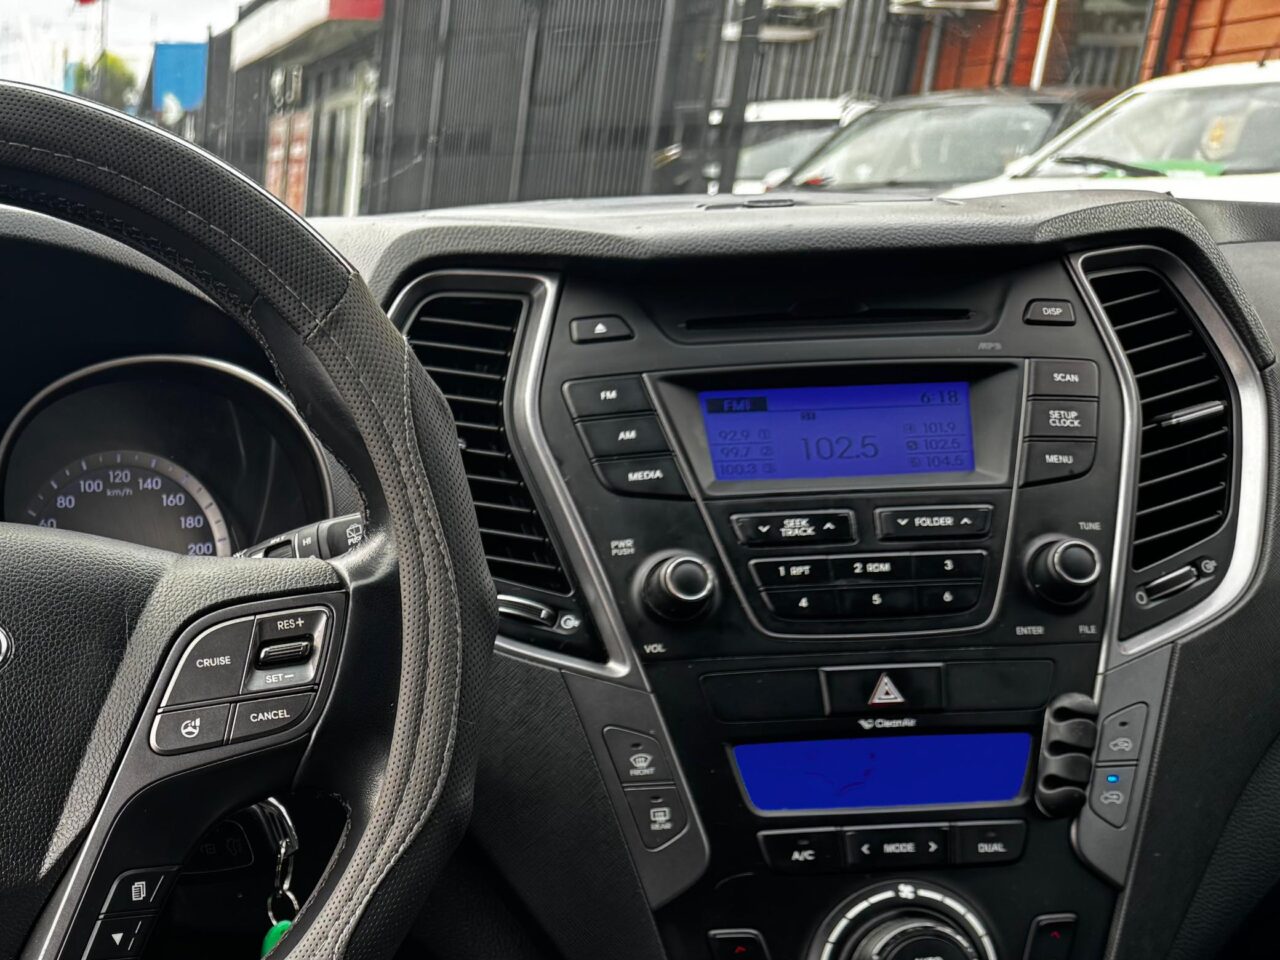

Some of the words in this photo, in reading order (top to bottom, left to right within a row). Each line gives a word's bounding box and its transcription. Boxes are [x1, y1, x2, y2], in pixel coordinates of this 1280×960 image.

[1042, 307, 1063, 316] DISP
[1053, 373, 1080, 382] SCAN
[600, 389, 618, 401] FM
[1048, 410, 1078, 419] SETUP
[1049, 419, 1081, 428] CLOCK
[618, 430, 637, 441] AM
[801, 435, 879, 461] 102.5
[1045, 455, 1073, 464] MENU
[109, 470, 131, 483] 120
[627, 469, 663, 481] MEDIA
[80, 480, 103, 493] 100
[138, 478, 162, 491] 140
[106, 488, 133, 497] km/h
[57, 496, 75, 509] 80
[162, 494, 185, 507] 160
[180, 516, 204, 529] 180
[783, 518, 809, 528] SEEK
[914, 517, 954, 527] FOLDER
[1078, 521, 1102, 531] TUNE
[780, 526, 815, 537] TRACK
[188, 543, 213, 556] 200
[610, 539, 634, 549] PWR
[611, 547, 635, 556] PUSH
[790, 565, 812, 576] RPT
[853, 562, 863, 574] 2
[944, 560, 953, 570] 3
[872, 594, 881, 604] 5
[943, 591, 953, 601] 6
[799, 597, 808, 607] 4
[277, 617, 305, 630] RES+
[1015, 626, 1045, 636] ENTER
[1078, 625, 1096, 634] FILE
[643, 643, 666, 654] VOL
[195, 655, 232, 669] CRUISE
[249, 709, 291, 723] CANCEL
[883, 842, 917, 854] MODE
[977, 842, 1008, 854] DUAL
[790, 849, 816, 862] A/C
